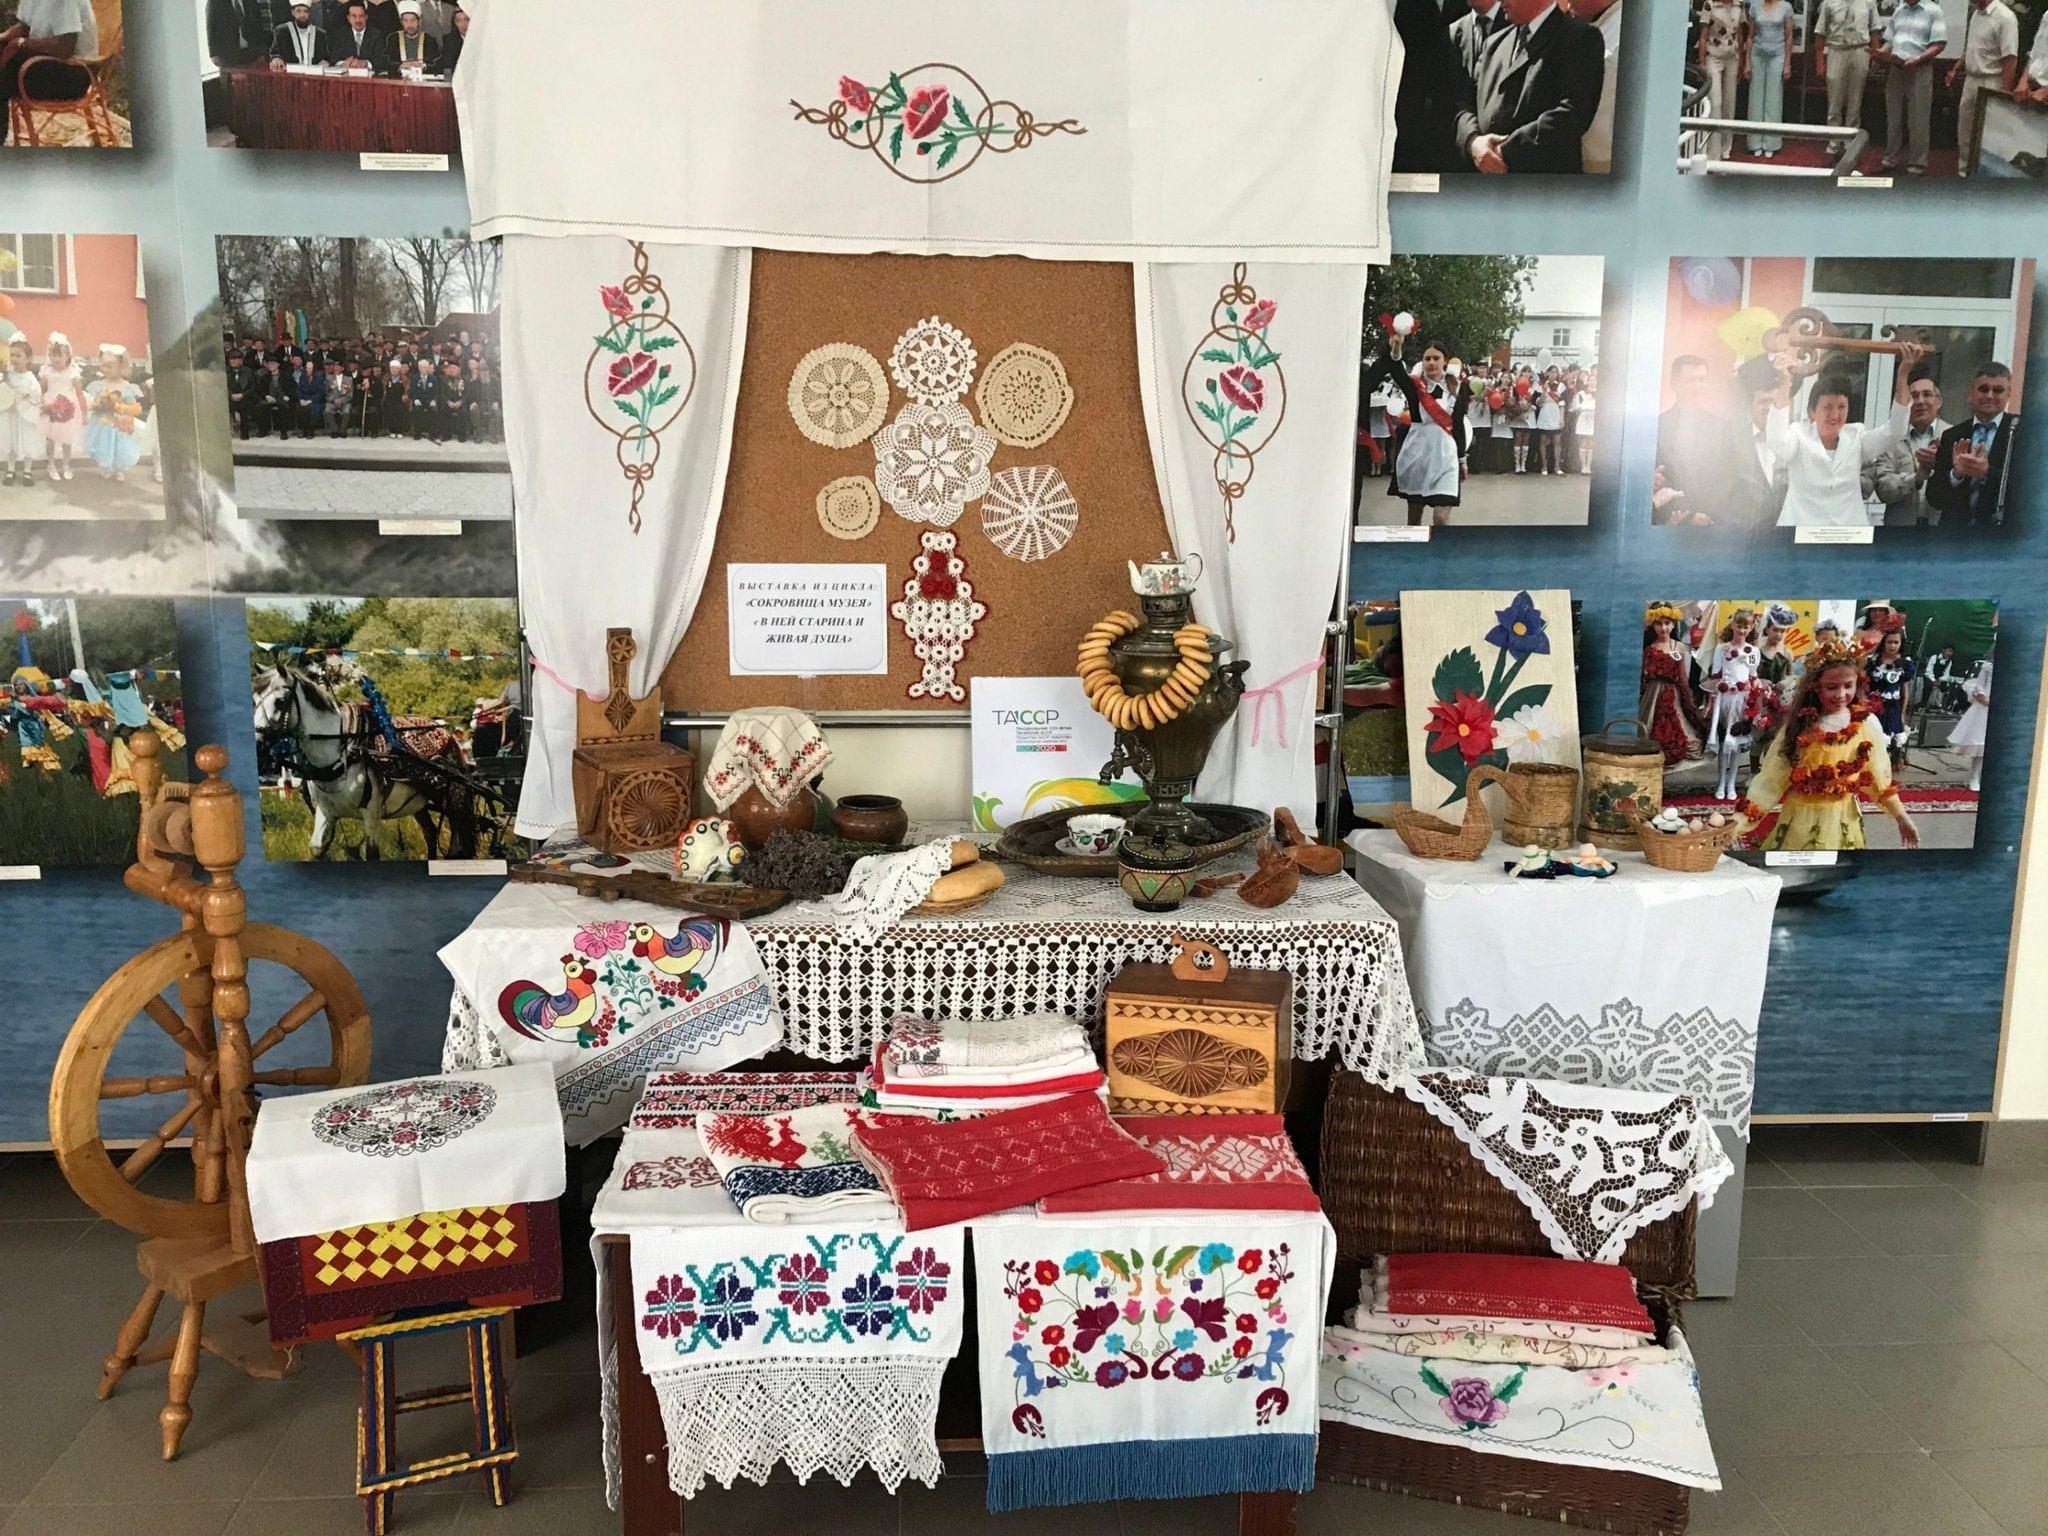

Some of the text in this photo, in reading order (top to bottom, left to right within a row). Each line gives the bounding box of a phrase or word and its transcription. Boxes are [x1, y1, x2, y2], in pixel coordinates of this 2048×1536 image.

[738, 582, 807, 591] ВЫСТАВКА
[813, 582, 828, 591] ИЗ
[745, 598, 872, 609] «СОКРОВИЩА МУЗЕЯ»
[771, 615, 796, 626] НЕЙ
[798, 617, 852, 627] СТАРИНА
[855, 617, 864, 627] И
[765, 634, 853, 645] ЖИВАЯ ДУША»
[1748, 655, 1756, 664] 15
